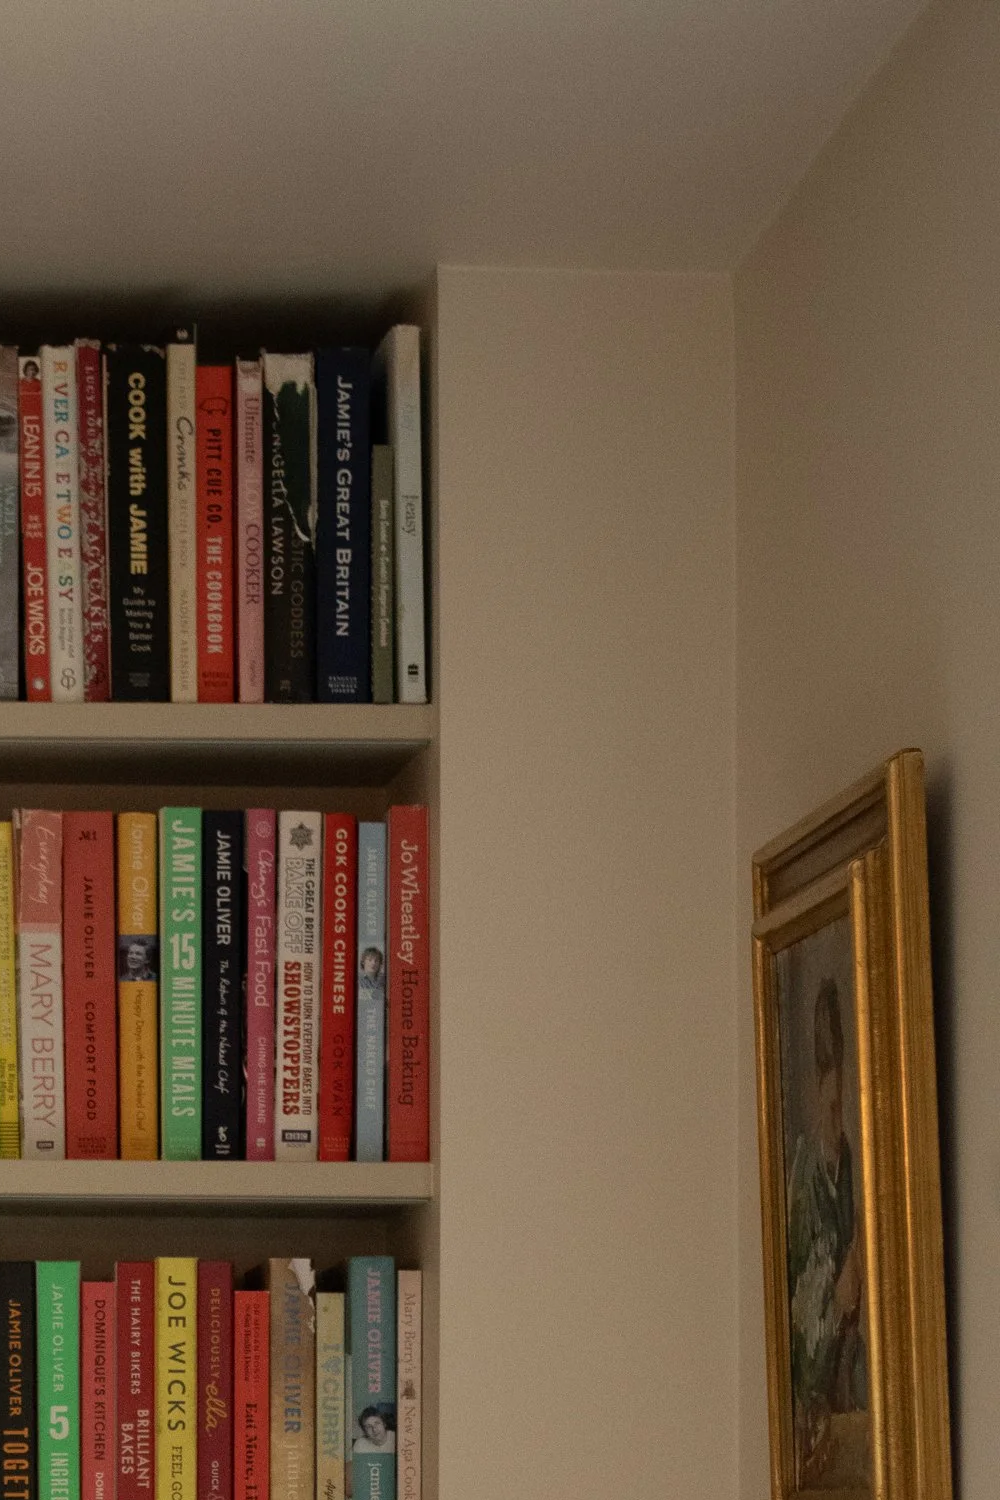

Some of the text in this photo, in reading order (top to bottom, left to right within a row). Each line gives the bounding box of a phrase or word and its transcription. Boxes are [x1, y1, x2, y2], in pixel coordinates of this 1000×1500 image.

[128, 372, 146, 440] COOK
[243, 398, 259, 463] Ultimate
[24, 416, 40, 496] LEAN IN 15
[129, 448, 146, 495] with
[177, 417, 193, 490] Cranks
[128, 504, 147, 574] JAMIE
[207, 429, 222, 653] PITT CUE THE COOKBOOK
[337, 375, 353, 636] JAMIE'S GREAT BRITAIN
[245, 523, 260, 604] COOKER
[271, 518, 284, 595] LAWSON
[26, 562, 45, 655] JOE WICKS
[89, 579, 103, 642] CAKES
[291, 580, 304, 658] GODDESS
[132, 876, 148, 930] Oliver
[216, 830, 230, 945] JAMIE OLIVER
[304, 859, 314, 954] THE GREAT BRITISH
[333, 828, 347, 1014] GOK COOKS CHINESE
[83, 876, 97, 1120] JAMIE OLIVER COMFORT FOOD
[171, 820, 195, 1116] JAMIE'S 15 MINUTE MEALS
[254, 916, 270, 1006] Fast Food
[398, 840, 420, 1105] Jo Wheatley Home Baking
[30, 943, 54, 1128] MARY BERRY
[283, 961, 301, 1115] SHOWSTOPPERS
[302, 962, 312, 1115] HOW TO TURN EVERYDAY BAKES INTO
[8, 1299, 21, 1350] JAMIE
[52, 1283, 64, 1329] JAMIE
[130, 1280, 141, 1395] THE HAIRY BIKERS
[167, 1275, 186, 1329] JOE
[210, 1288, 220, 1378] DELICIOUSLY
[401, 1292, 415, 1326] Mary
[8, 1354, 22, 1416] OLIVER
[52, 1334, 64, 1392] OLIVER
[93, 1299, 106, 1396] DOMINIQUE'S
[167, 1341, 185, 1431] WICKS
[93, 1401, 105, 1460] KITCHEN
[121, 1422, 134, 1474] BAKES
[136, 1409, 150, 1488] BRILLIANT
[404, 1405, 415, 1434] New
[170, 1445, 182, 1477] FEEL
[211, 1460, 219, 1490] QUICK
